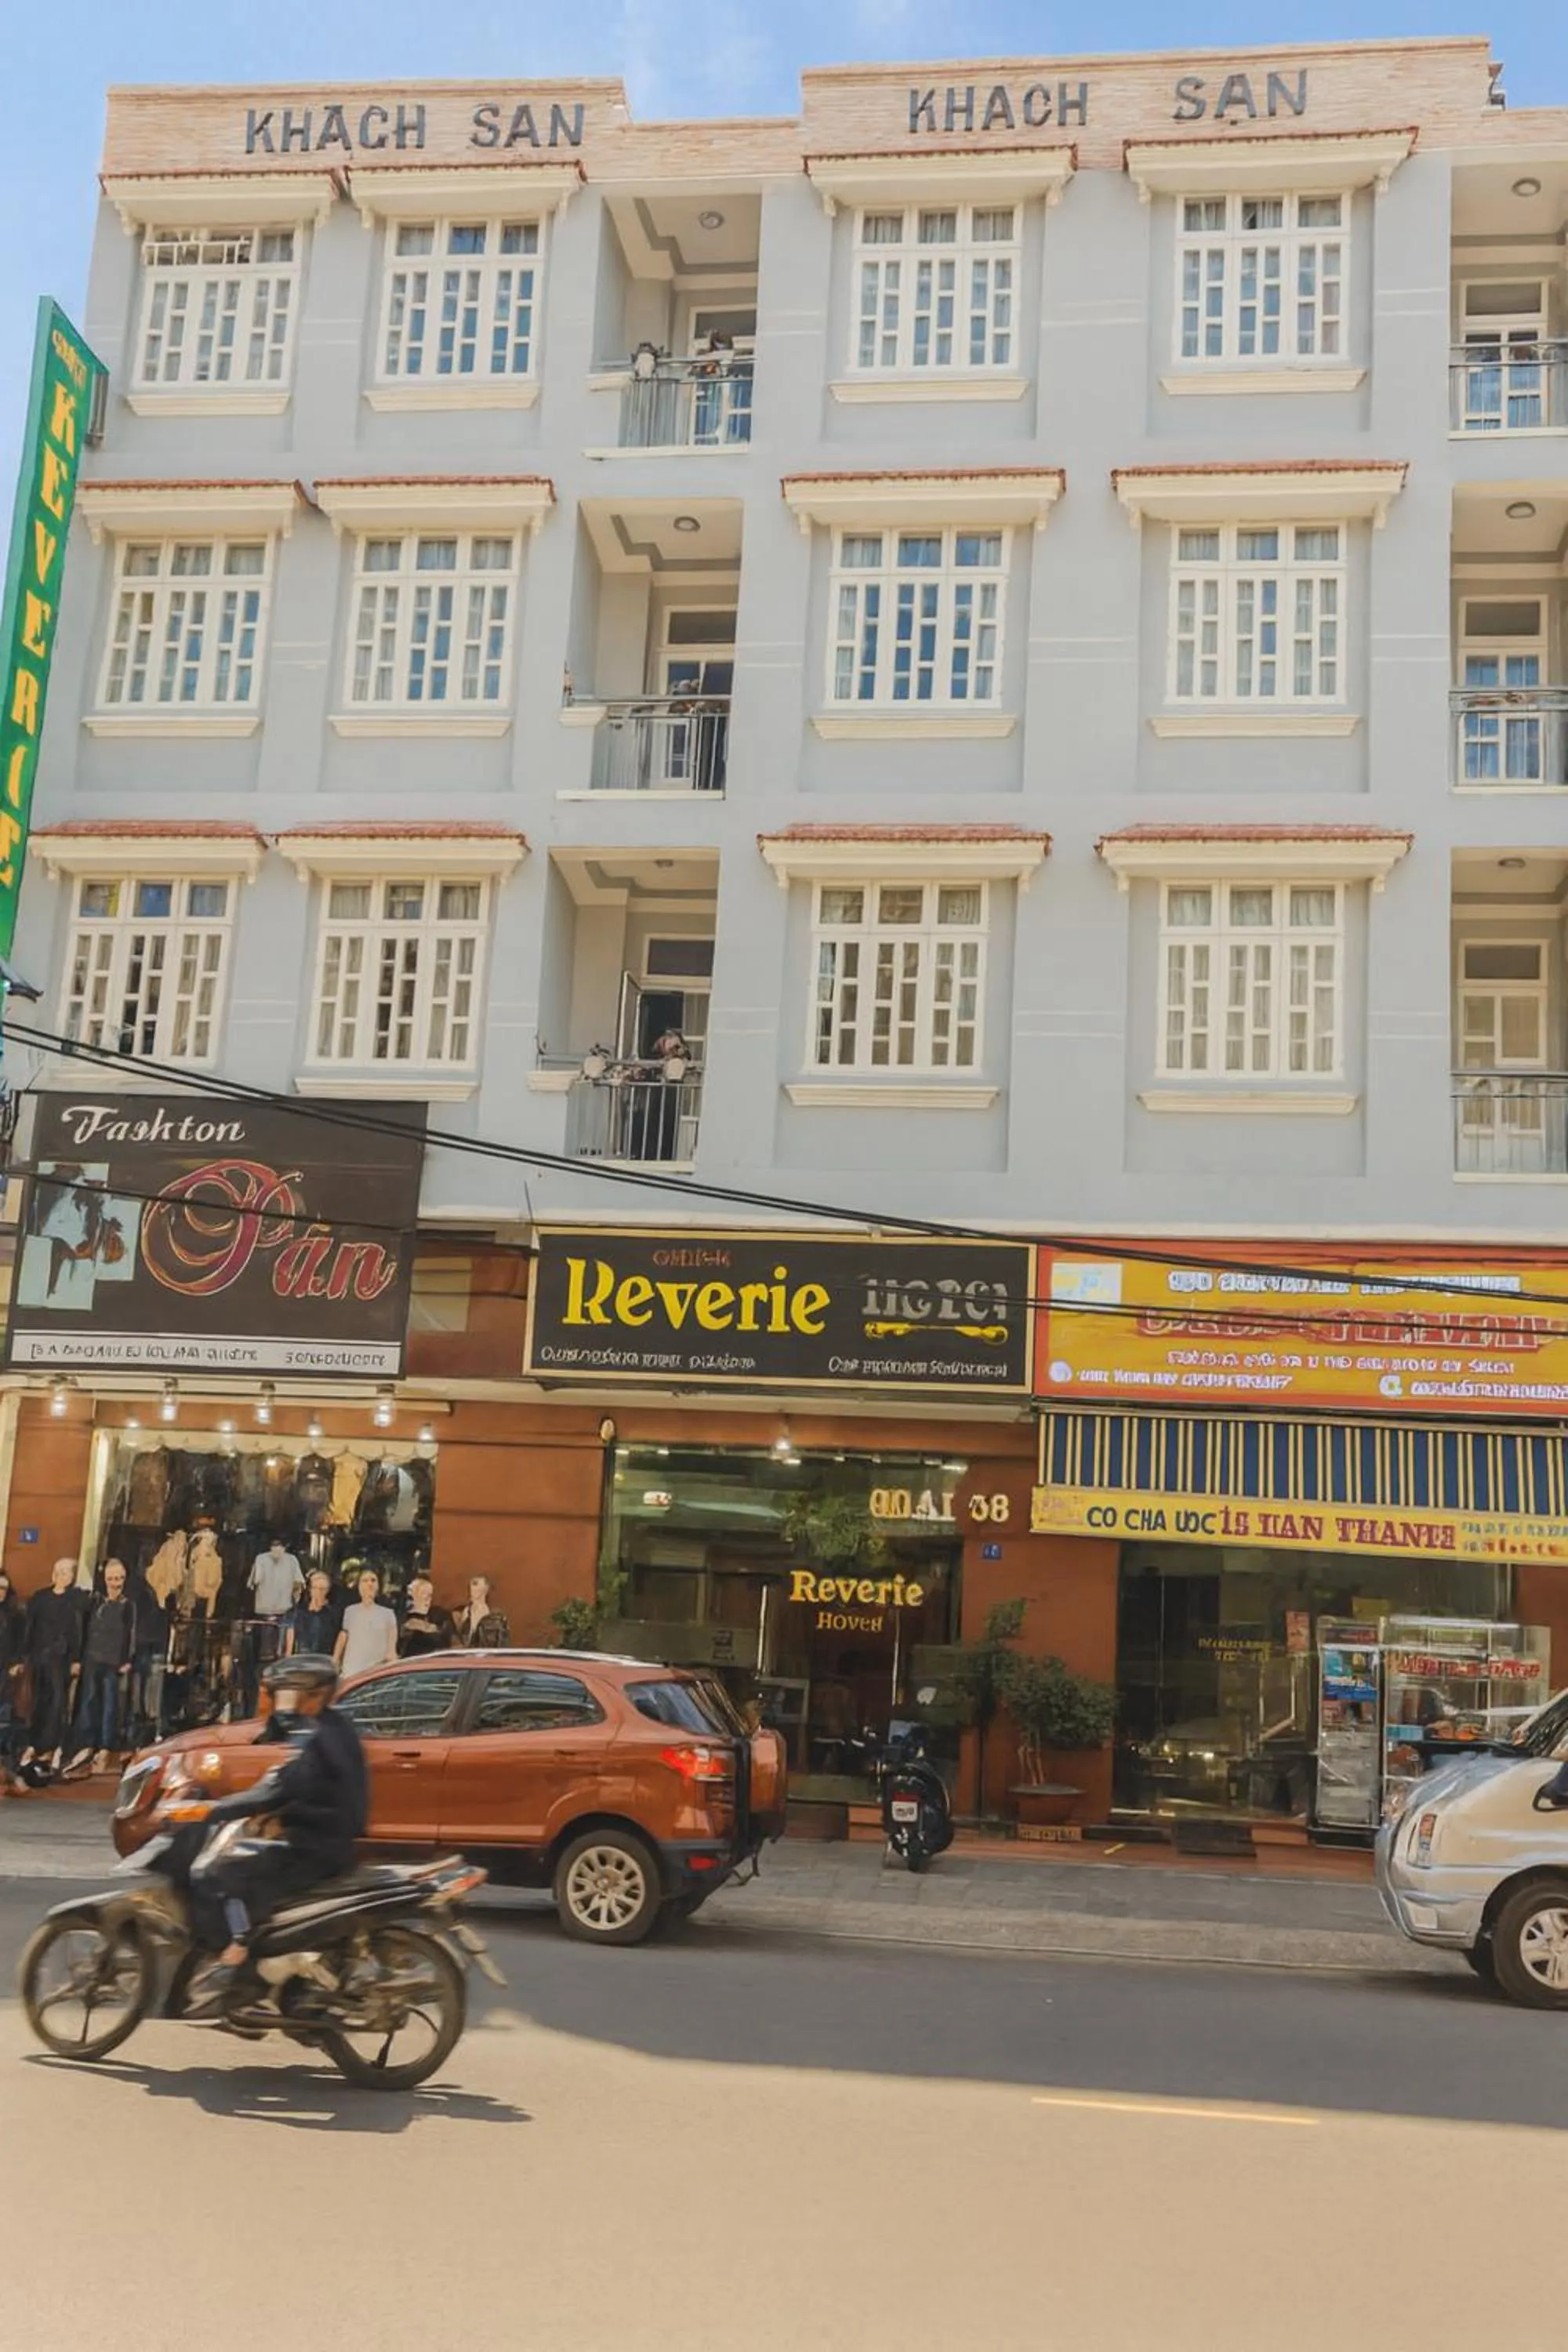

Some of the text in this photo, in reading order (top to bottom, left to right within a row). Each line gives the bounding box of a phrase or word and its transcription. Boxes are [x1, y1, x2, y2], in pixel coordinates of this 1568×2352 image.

[469, 102, 585, 148] SAN
[909, 82, 1088, 133] KHACH
[561, 1256, 831, 1335] Reverie
[789, 1570, 924, 1606] Reverie
